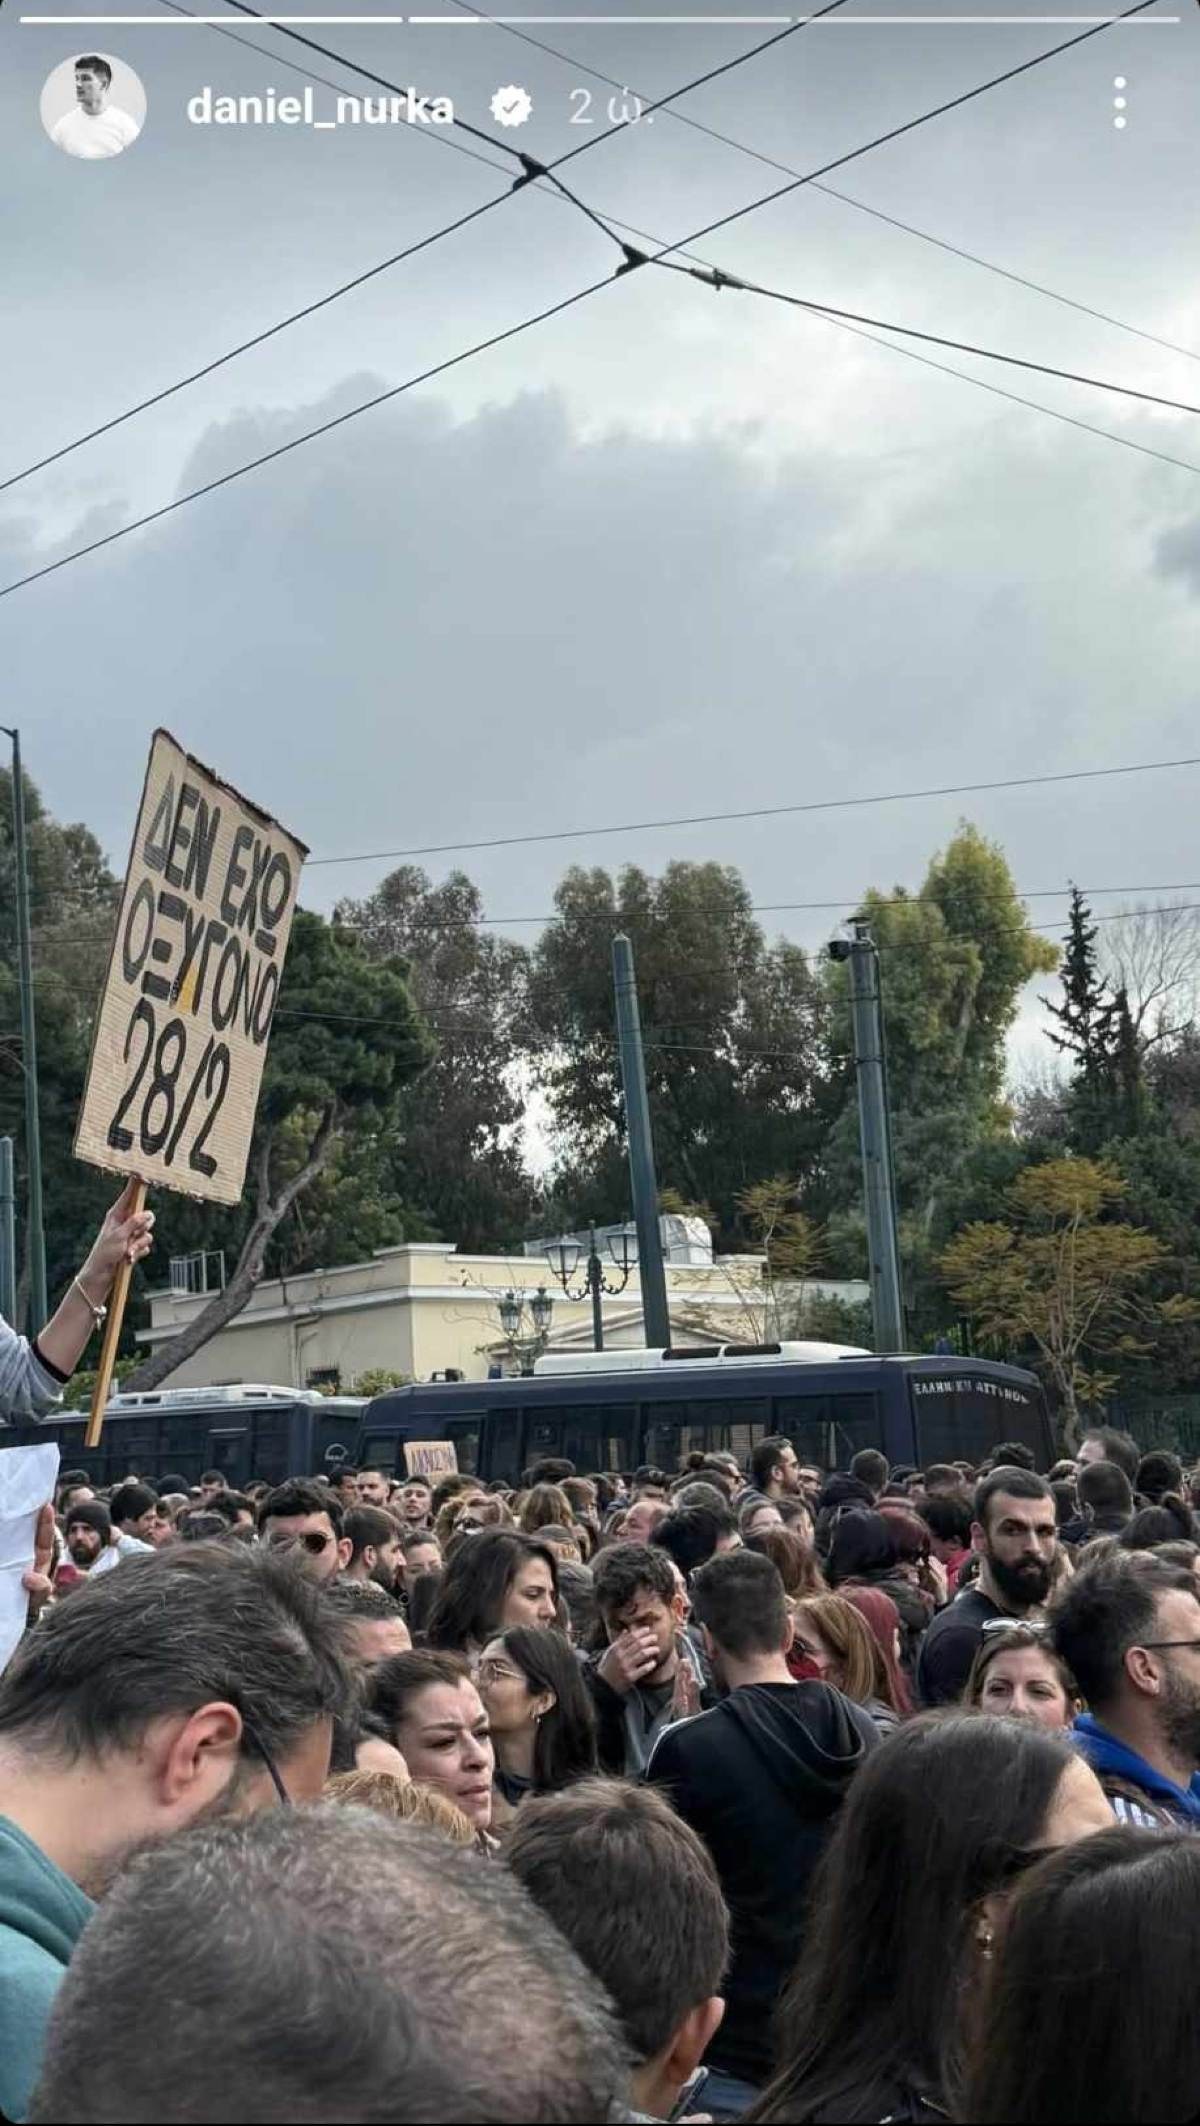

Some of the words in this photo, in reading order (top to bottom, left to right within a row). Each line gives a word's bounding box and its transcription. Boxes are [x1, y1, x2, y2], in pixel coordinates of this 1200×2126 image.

[142, 771, 221, 903] ΔΕΝ
[122, 877, 278, 1046] ΟΞΥΓΟΝΟ
[106, 997, 230, 1177] 28/2
